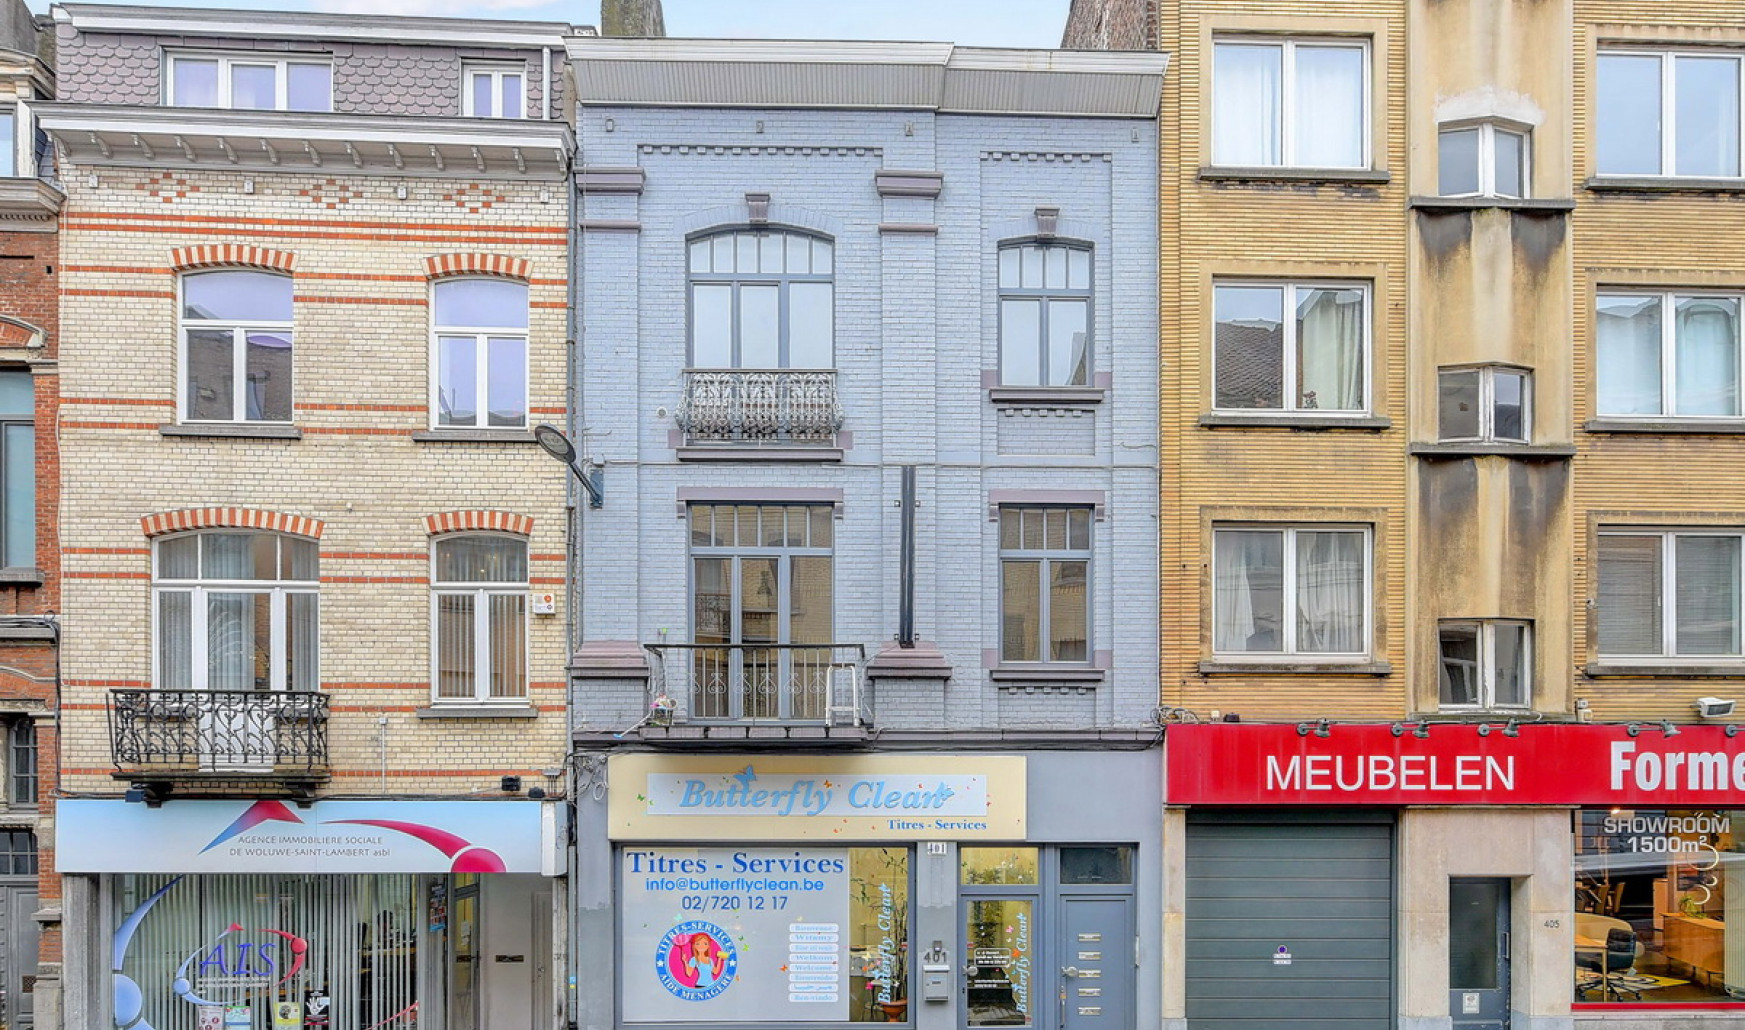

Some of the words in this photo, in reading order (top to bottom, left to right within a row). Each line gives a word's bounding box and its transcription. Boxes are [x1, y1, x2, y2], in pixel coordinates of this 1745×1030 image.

[1266, 755, 1515, 791] MEUBELEN
[679, 778, 833, 817] Butterfly
[848, 780, 947, 810] Clean
[887, 819, 924, 830] Titres
[935, 819, 987, 830] Services
[1604, 816, 1730, 834] SHOWROOM
[238, 836, 277, 844] AGENCE
[278, 836, 342, 844] IMMOBILIERE
[345, 836, 383, 844] SOCIALE
[229, 848, 242, 856] DE
[245, 848, 370, 856] WOLUWE-SAINT-LAMBERT
[372, 848, 391, 856] asbl
[626, 852, 707, 874] Titres
[732, 852, 844, 874] Services
[646, 877, 824, 893] info@butterflyclean.be
[681, 895, 741, 913] 02/720
[748, 896, 765, 910] 12
[772, 896, 788, 910] 17
[877, 884, 891, 931] Clean
[1015, 913, 1028, 952] Clean
[1543, 919, 1560, 929] 405
[198, 942, 277, 977] AIS
[923, 951, 948, 963] 401
[877, 936, 895, 1004] Butterfly
[1015, 956, 1031, 1013] Butterfly
